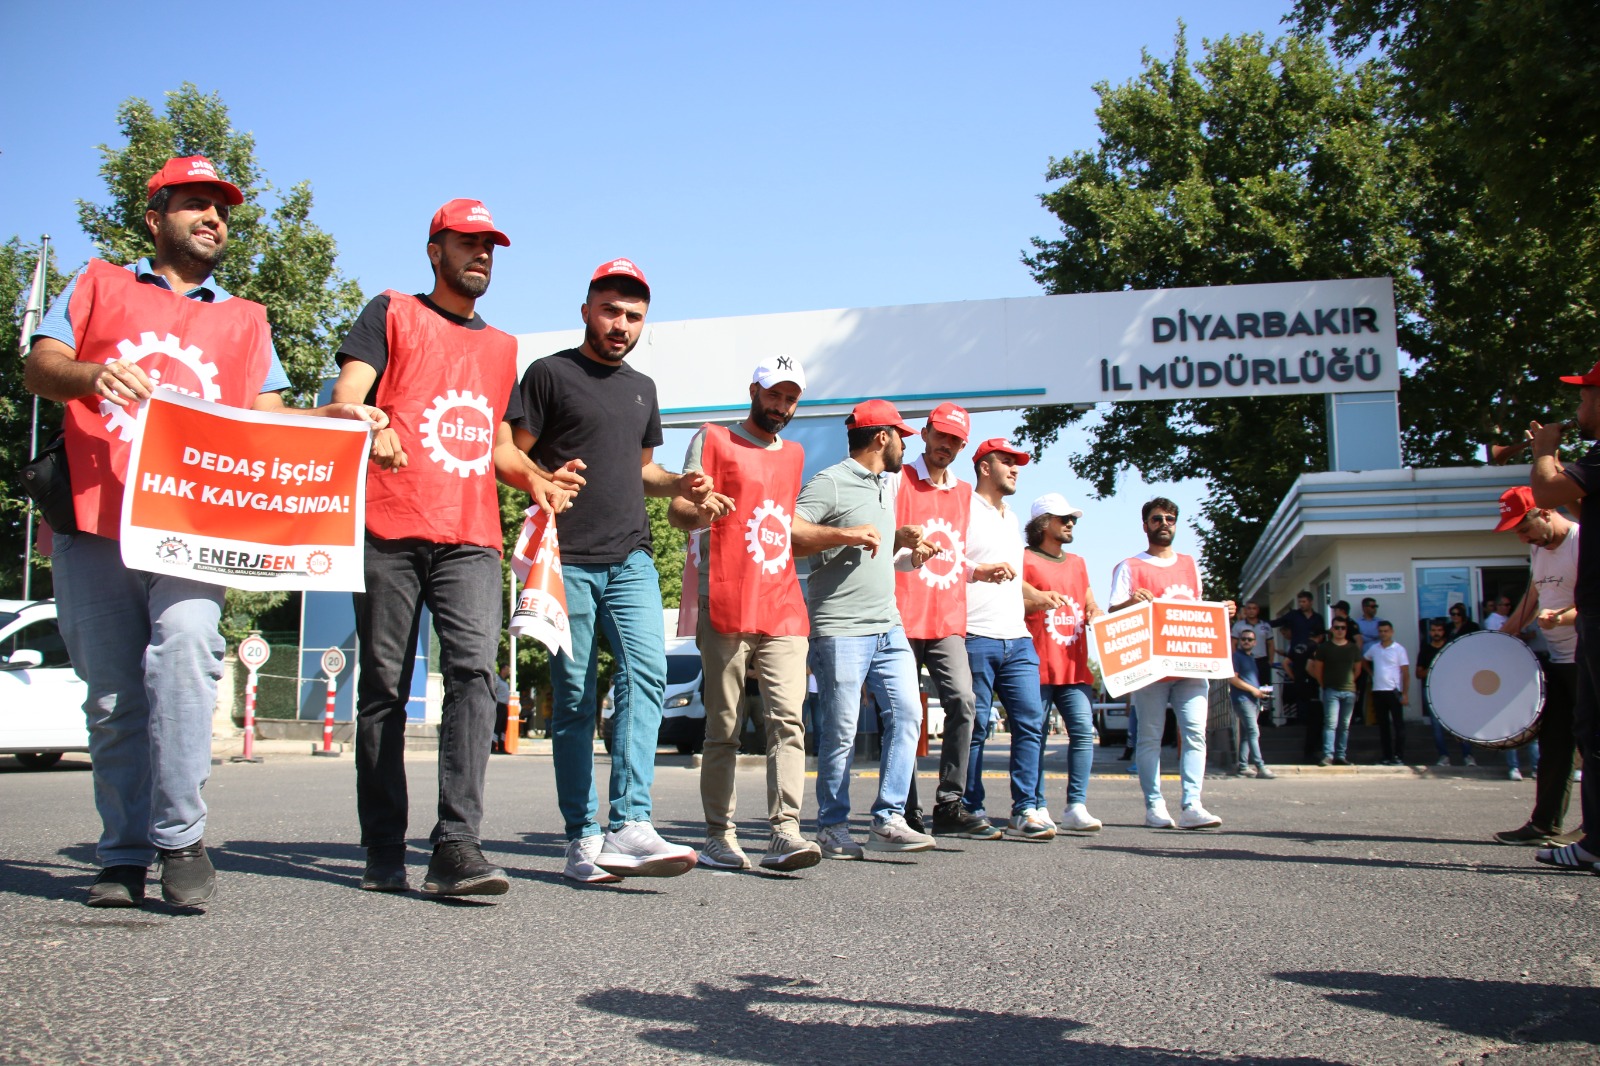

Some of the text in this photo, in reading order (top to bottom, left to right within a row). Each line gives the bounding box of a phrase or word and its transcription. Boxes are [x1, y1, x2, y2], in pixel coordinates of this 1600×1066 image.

[1152, 307, 1379, 343] DİYARBAKIR
[776, 355, 793, 371] NY
[1101, 347, 1381, 391] İL MÜDÜRLÜĞÜ
[440, 417, 490, 445] DİSK
[182, 446, 335, 486] DEDAŞ İŞÇİSİ
[142, 472, 350, 514] HAK KAVGASINDA!
[1103, 627, 1150, 655] BASKISINA
[1160, 624, 1218, 639] ANAYASAL
[247, 646, 262, 657] 20
[1120, 647, 1143, 666] SON!
[1166, 640, 1213, 654] HAKTIR!
[328, 656, 340, 666] 20
